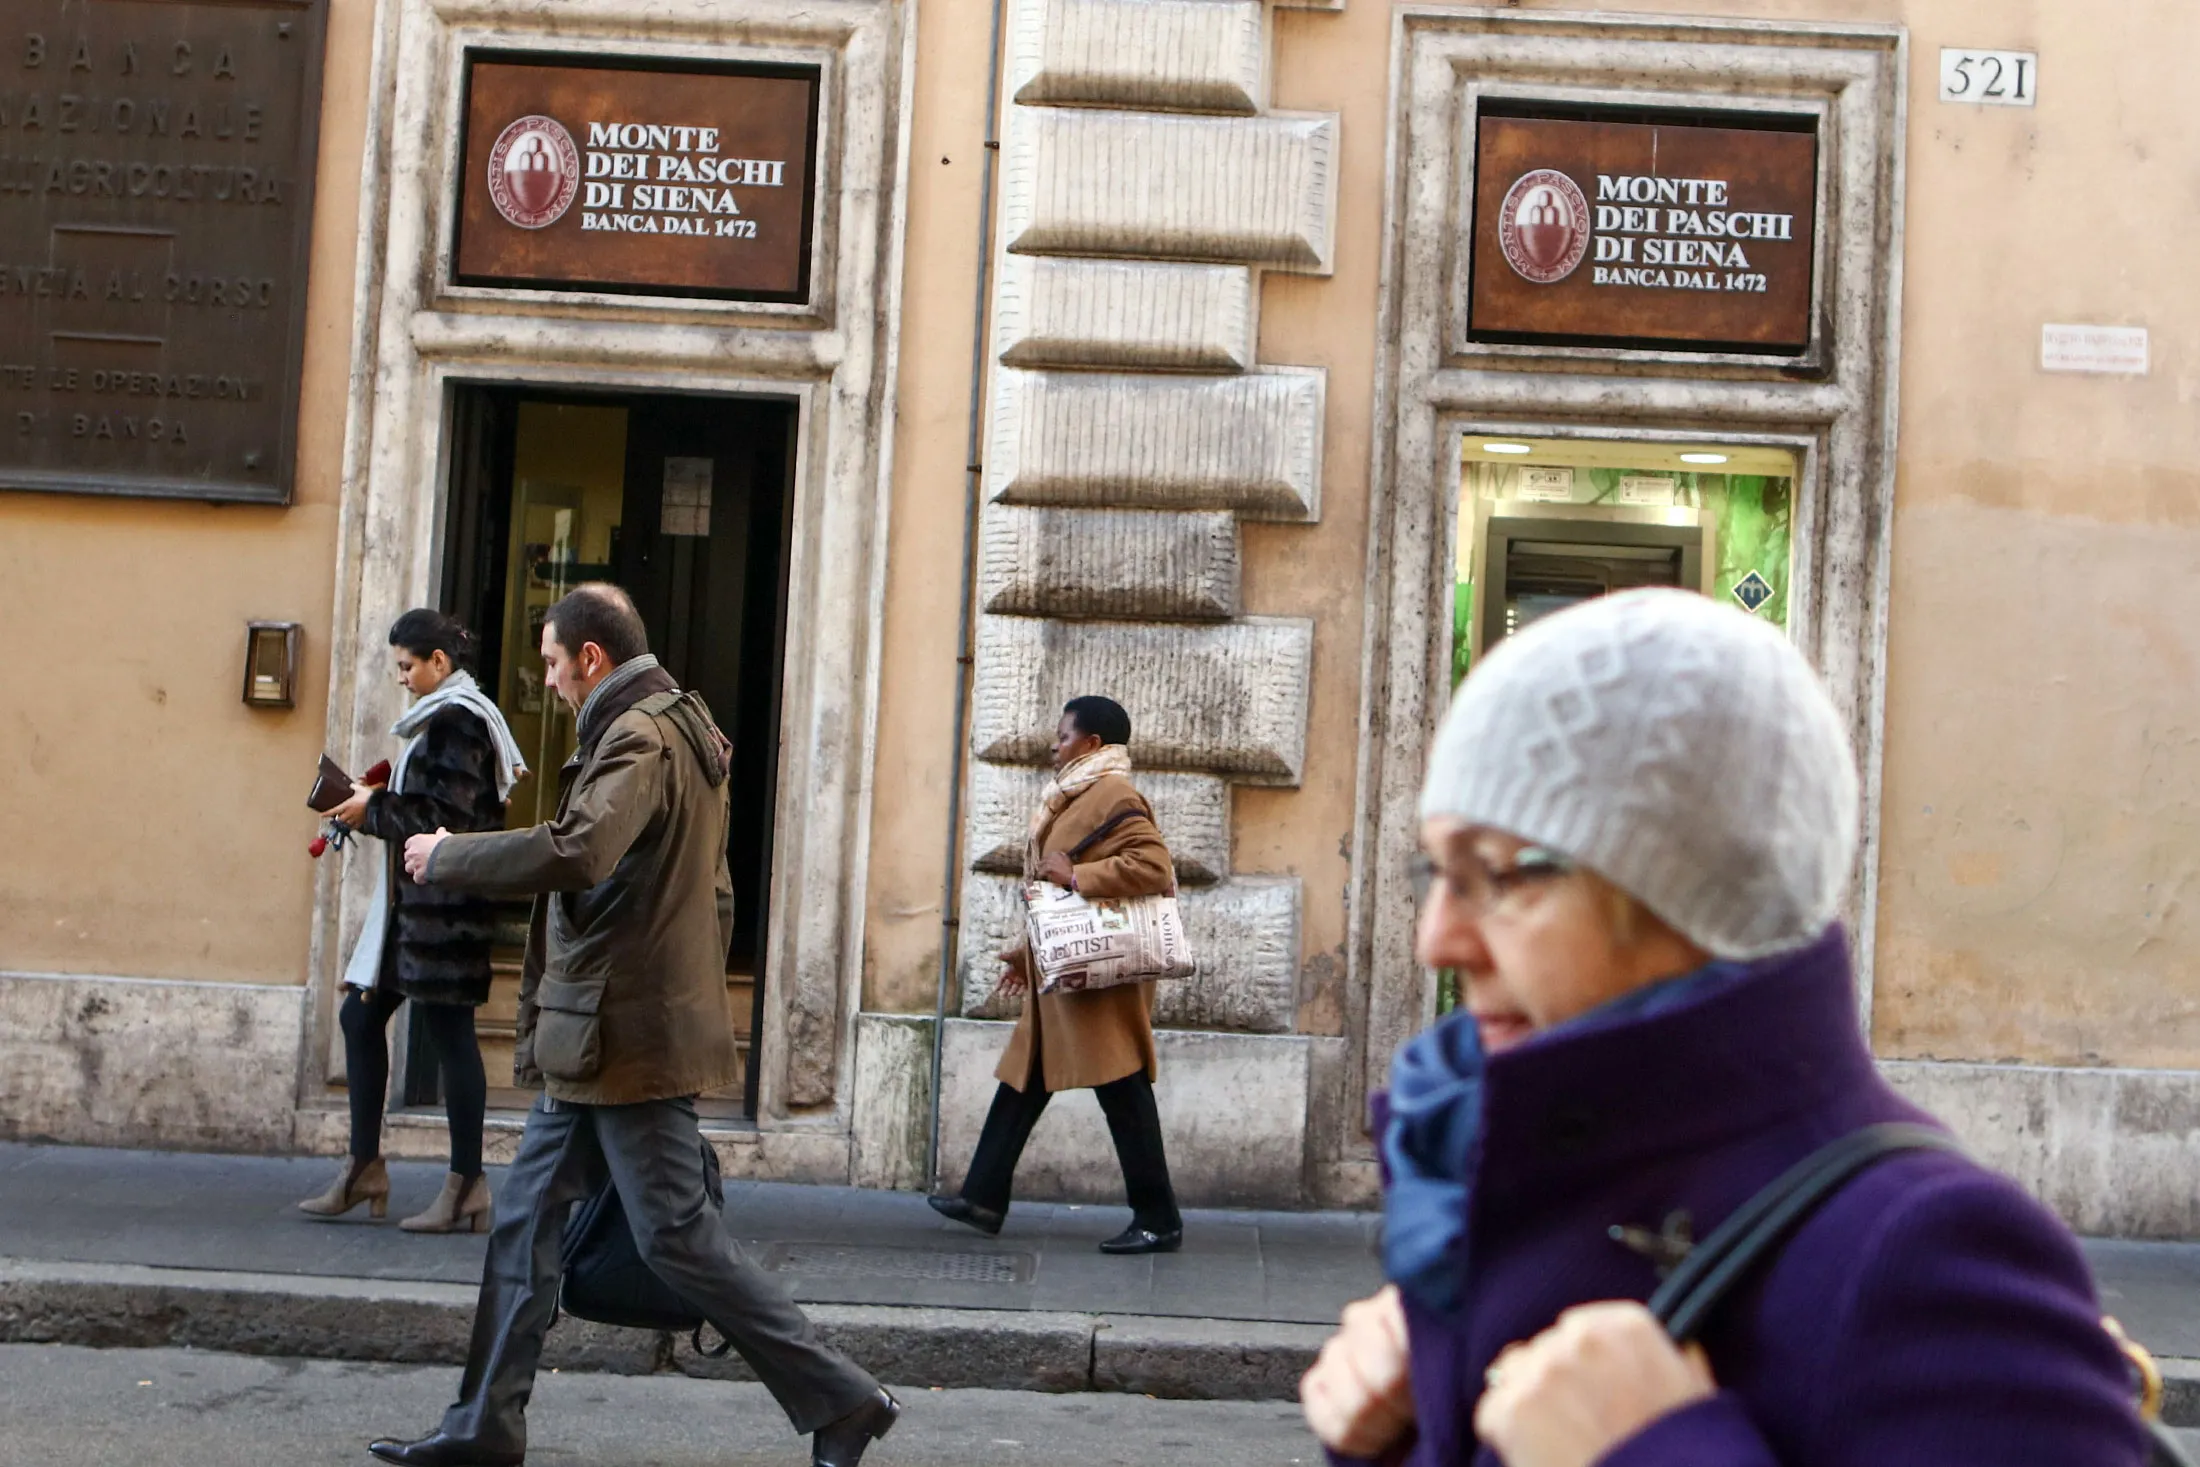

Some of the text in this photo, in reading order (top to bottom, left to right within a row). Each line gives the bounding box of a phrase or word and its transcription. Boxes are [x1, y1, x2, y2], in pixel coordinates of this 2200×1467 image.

[23, 32, 236, 80] BANCA
[1947, 56, 2029, 99] 521
[587, 122, 719, 153] MONTE
[584, 152, 786, 187] DEI PASCHI
[583, 182, 740, 215] DI SIENA
[1597, 175, 1728, 206] MONTE
[581, 212, 758, 239] BANCA DAL 1472
[1595, 205, 1793, 240] DEI PASCHI
[1594, 235, 1750, 269] DI SIENA
[1593, 266, 1767, 293] BANCA DAL 1472
[46, 366, 79, 392] LE
[91, 368, 258, 400] OPERAZION
[72, 413, 189, 444] BANCA
